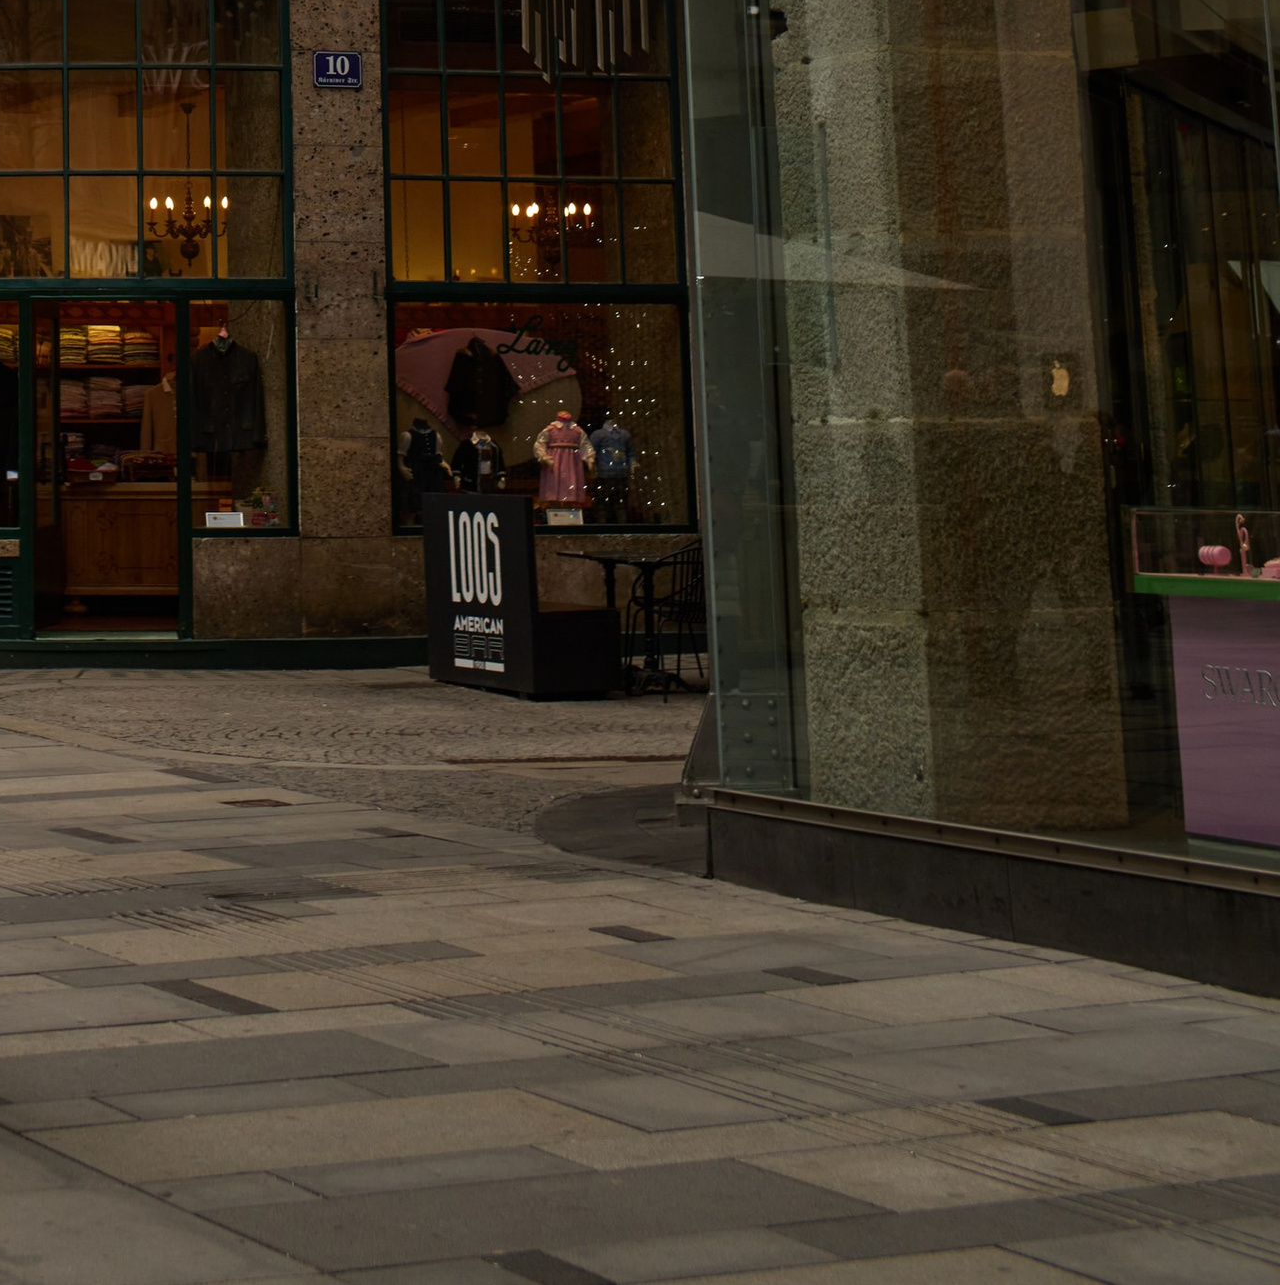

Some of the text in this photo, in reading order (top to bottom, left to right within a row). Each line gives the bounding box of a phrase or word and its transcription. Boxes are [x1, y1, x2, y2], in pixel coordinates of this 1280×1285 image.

[325, 55, 350, 76] 10
[448, 510, 503, 607] LOOS
[453, 615, 504, 636] AMERICAN
[453, 633, 505, 661] BAR
